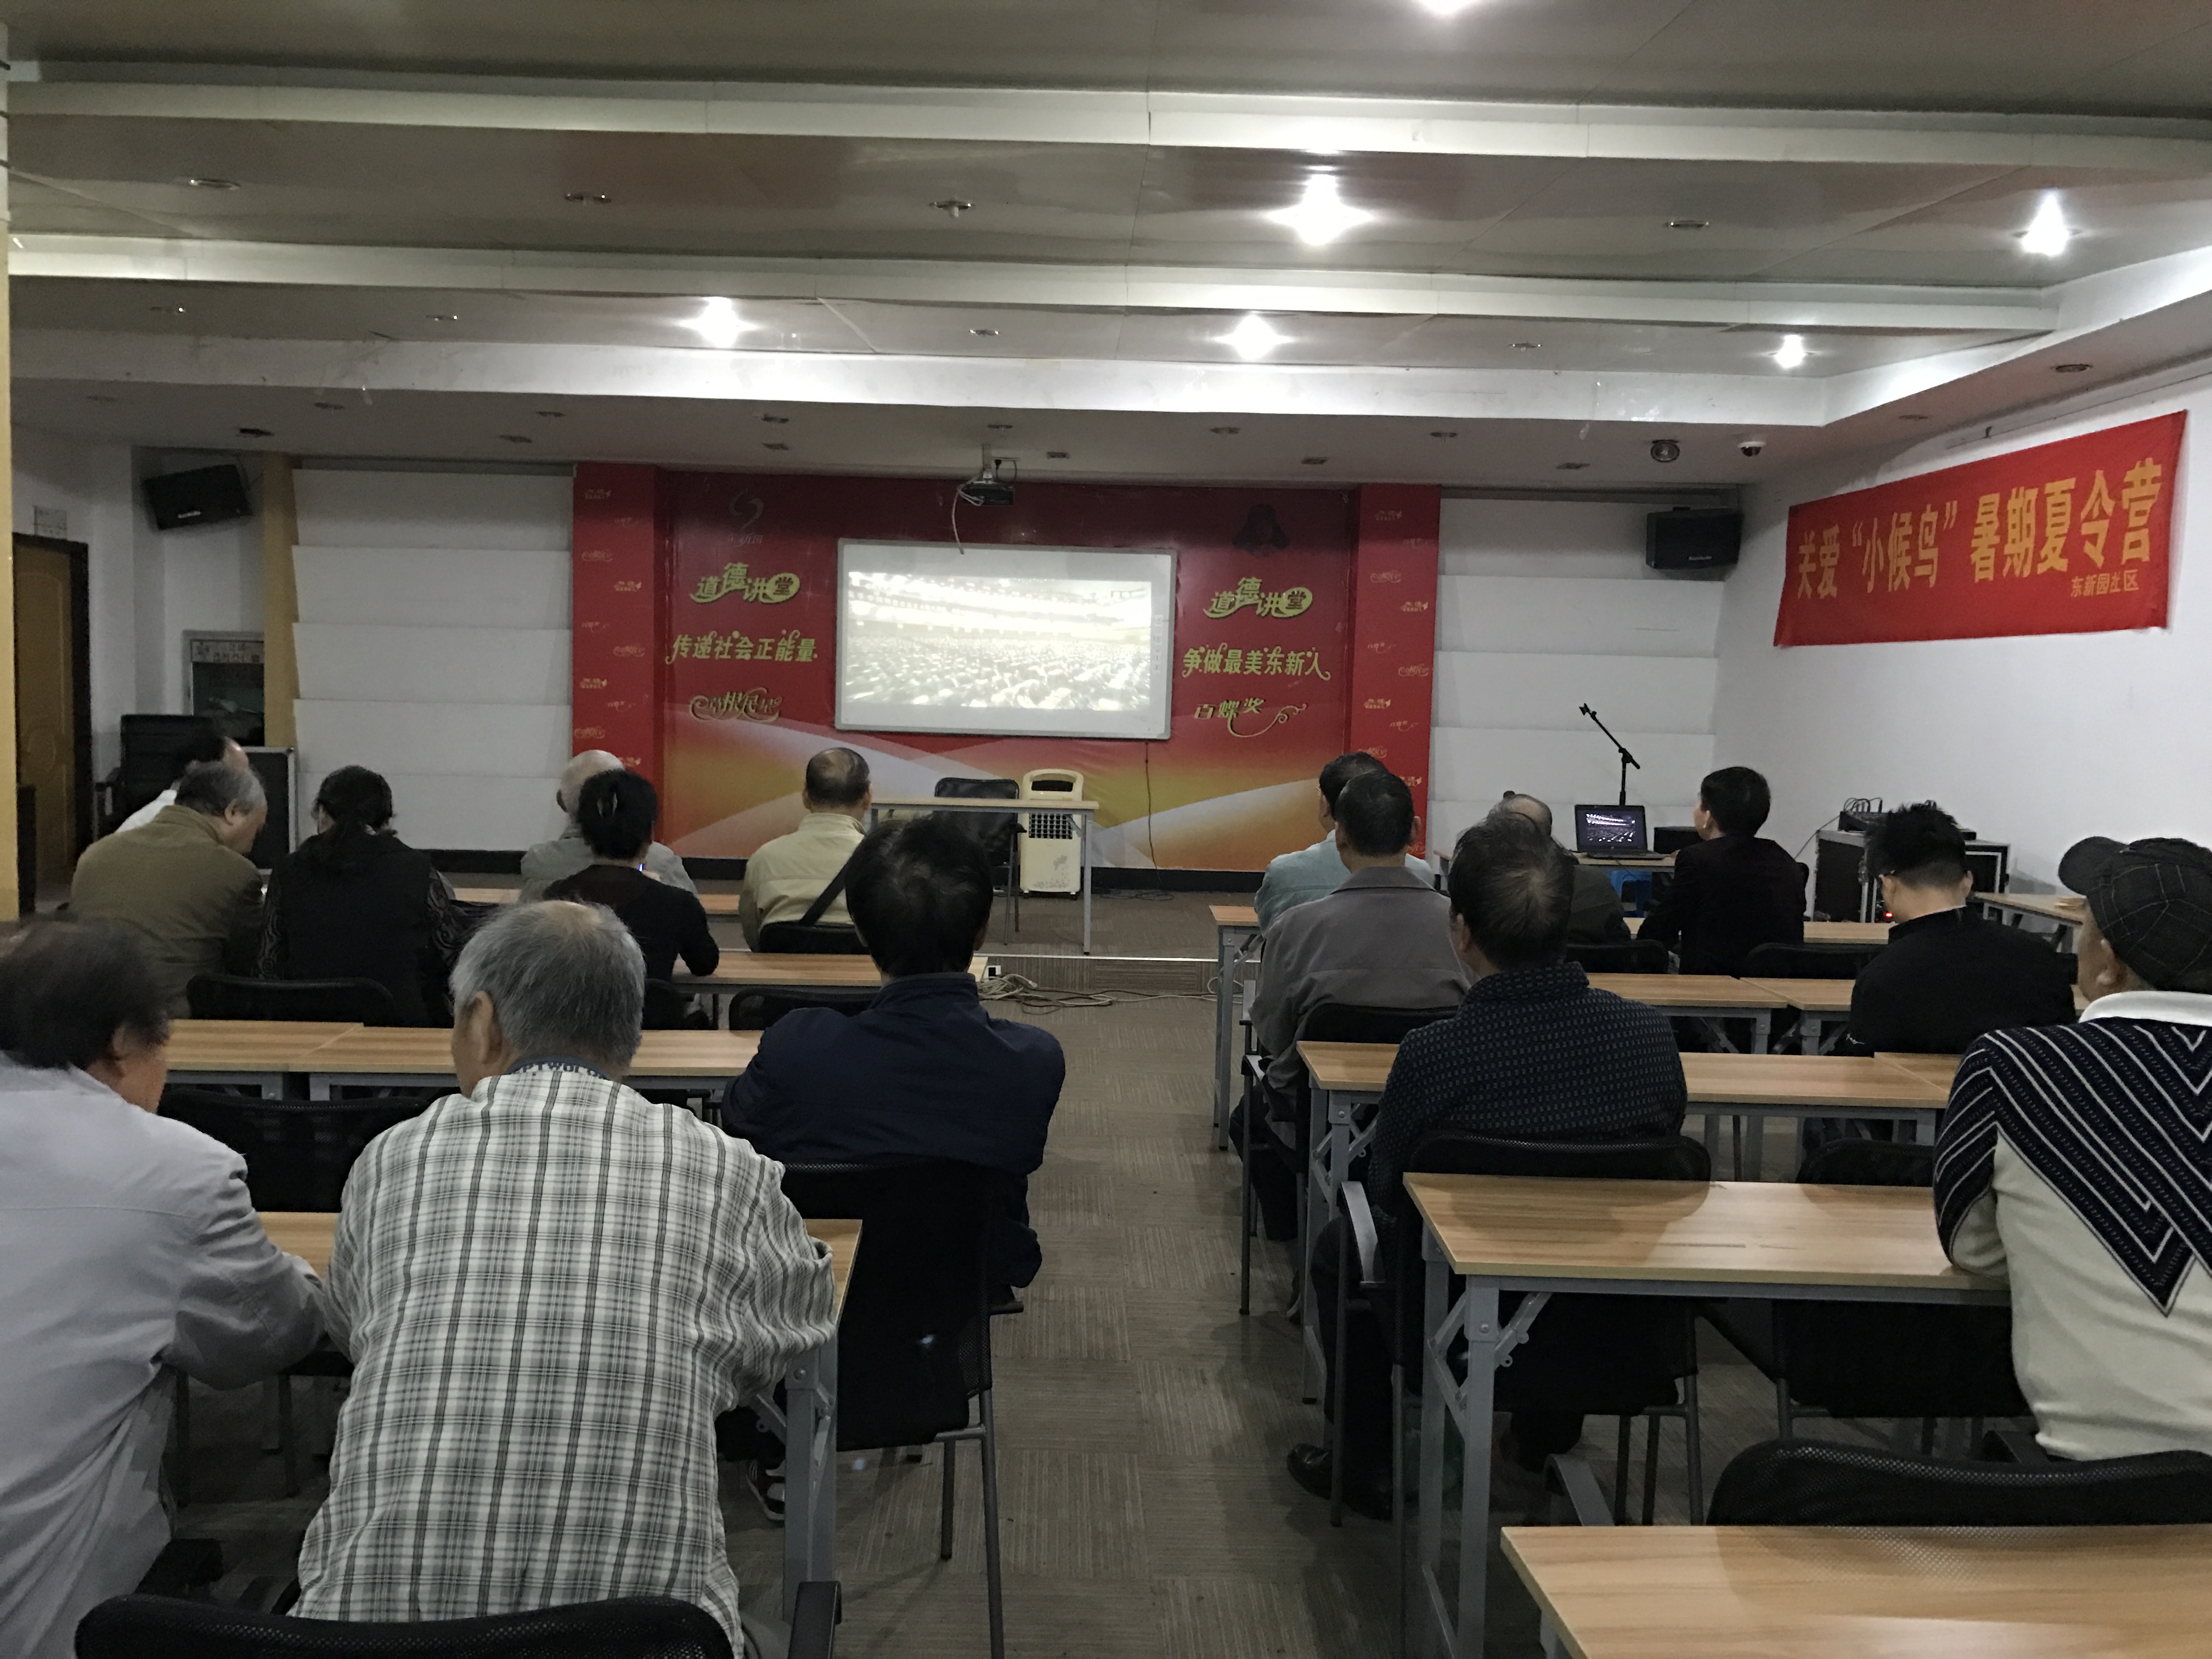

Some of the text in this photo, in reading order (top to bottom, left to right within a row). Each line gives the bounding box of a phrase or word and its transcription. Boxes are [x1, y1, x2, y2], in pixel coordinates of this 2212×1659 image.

[690, 562, 800, 603] 道德讲堂
[1203, 577, 1313, 619] 道德讲堂
[2070, 569, 2140, 597] 东新园社区
[665, 629, 816, 664] 传递社会正能量
[1182, 642, 1331, 680] 争做最美东新人
